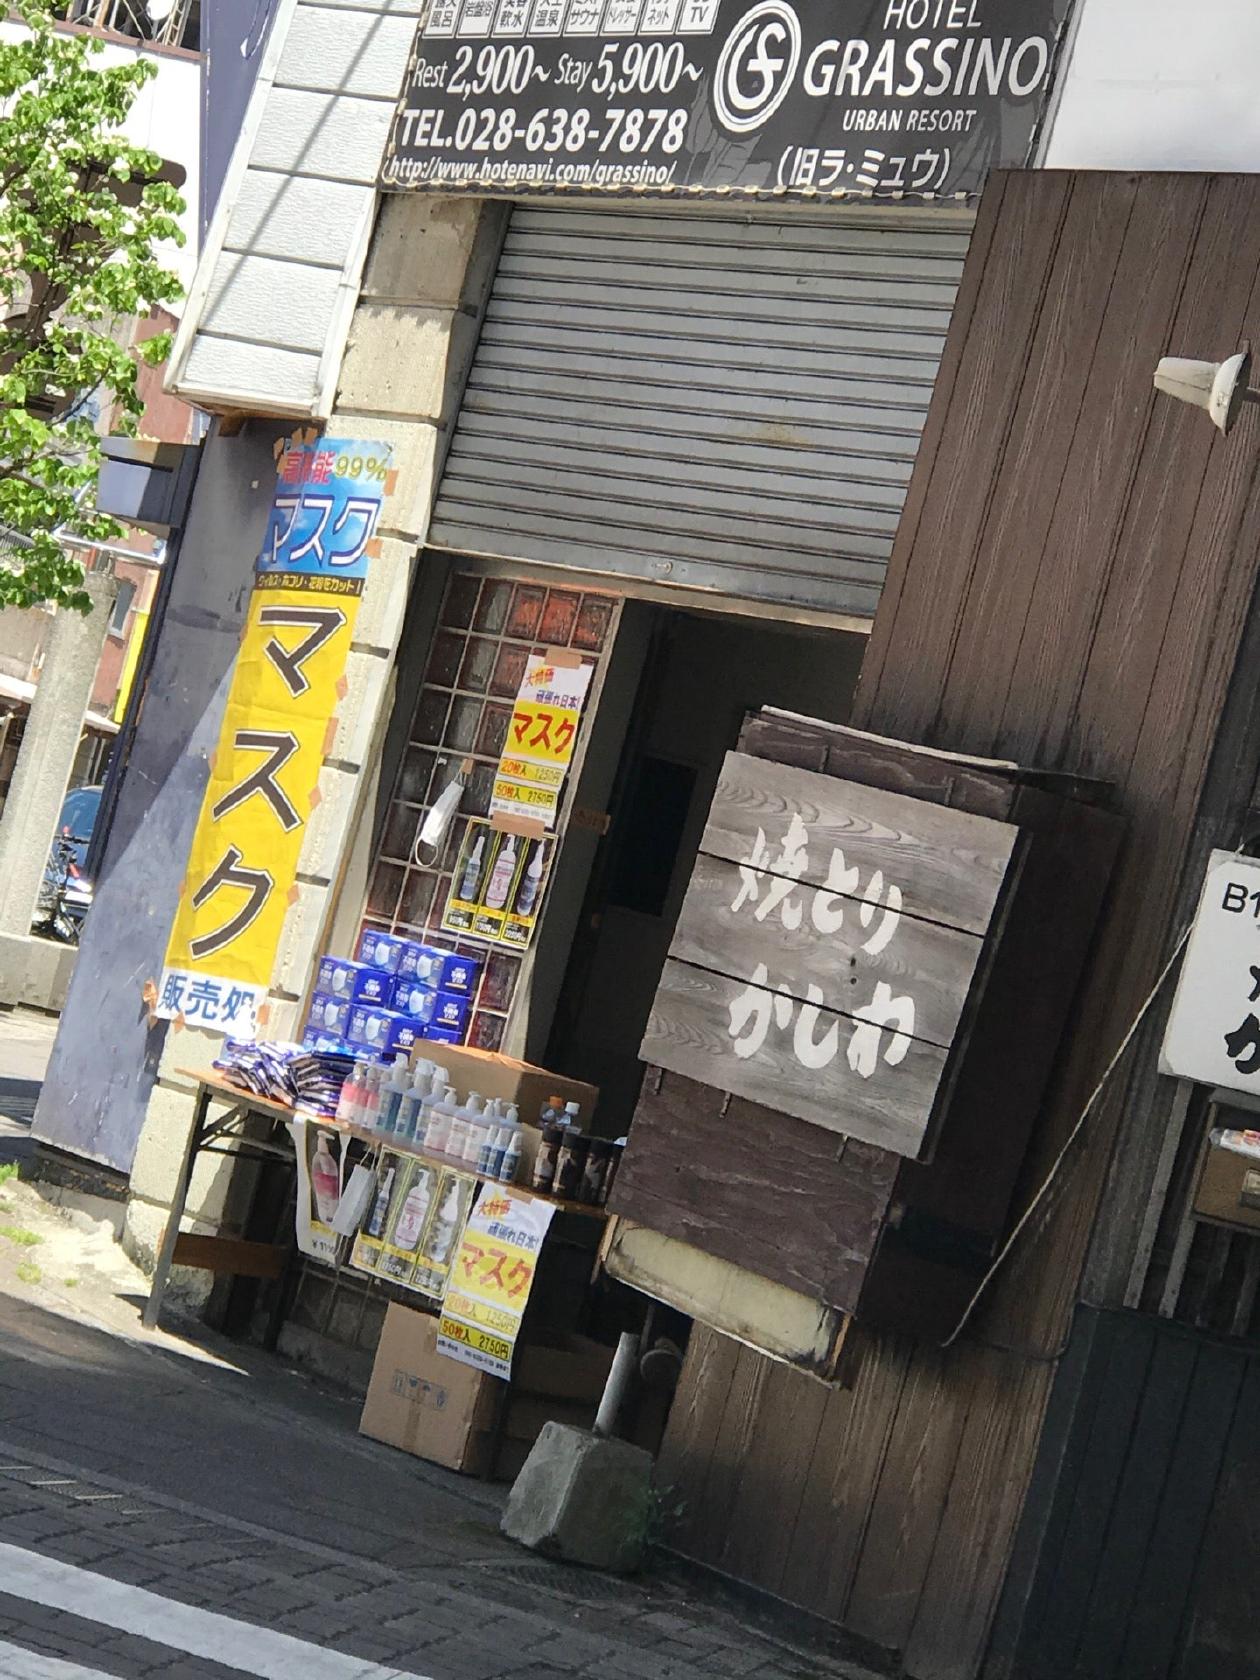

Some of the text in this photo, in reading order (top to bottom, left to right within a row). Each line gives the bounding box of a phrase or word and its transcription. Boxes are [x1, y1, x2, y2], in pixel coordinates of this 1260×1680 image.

[430, 10, 454, 28] 風呂
[535, 10, 560, 27] 温泉
[570, 8, 599, 25] サウナ
[690, 6, 709, 23] TV
[883, 0, 982, 30] HOTEL
[412, 57, 448, 88] Rest
[554, 53, 593, 94] Stay
[803, 36, 1049, 97] GRASSINO
[400, 107, 689, 154] TEL.028-638-7878
[842, 109, 978, 132] URBAN RESORT
[388, 155, 678, 187] http://www.hotenavi.com/grassino/
[513, 711, 576, 755] マスク
[188, 605, 347, 961] マスク
[728, 962, 916, 1079] かしわ
[462, 1241, 533, 1298] マスク
[442, 1319, 472, 1345] 50枚入
[479, 1333, 511, 1361] 2750円
